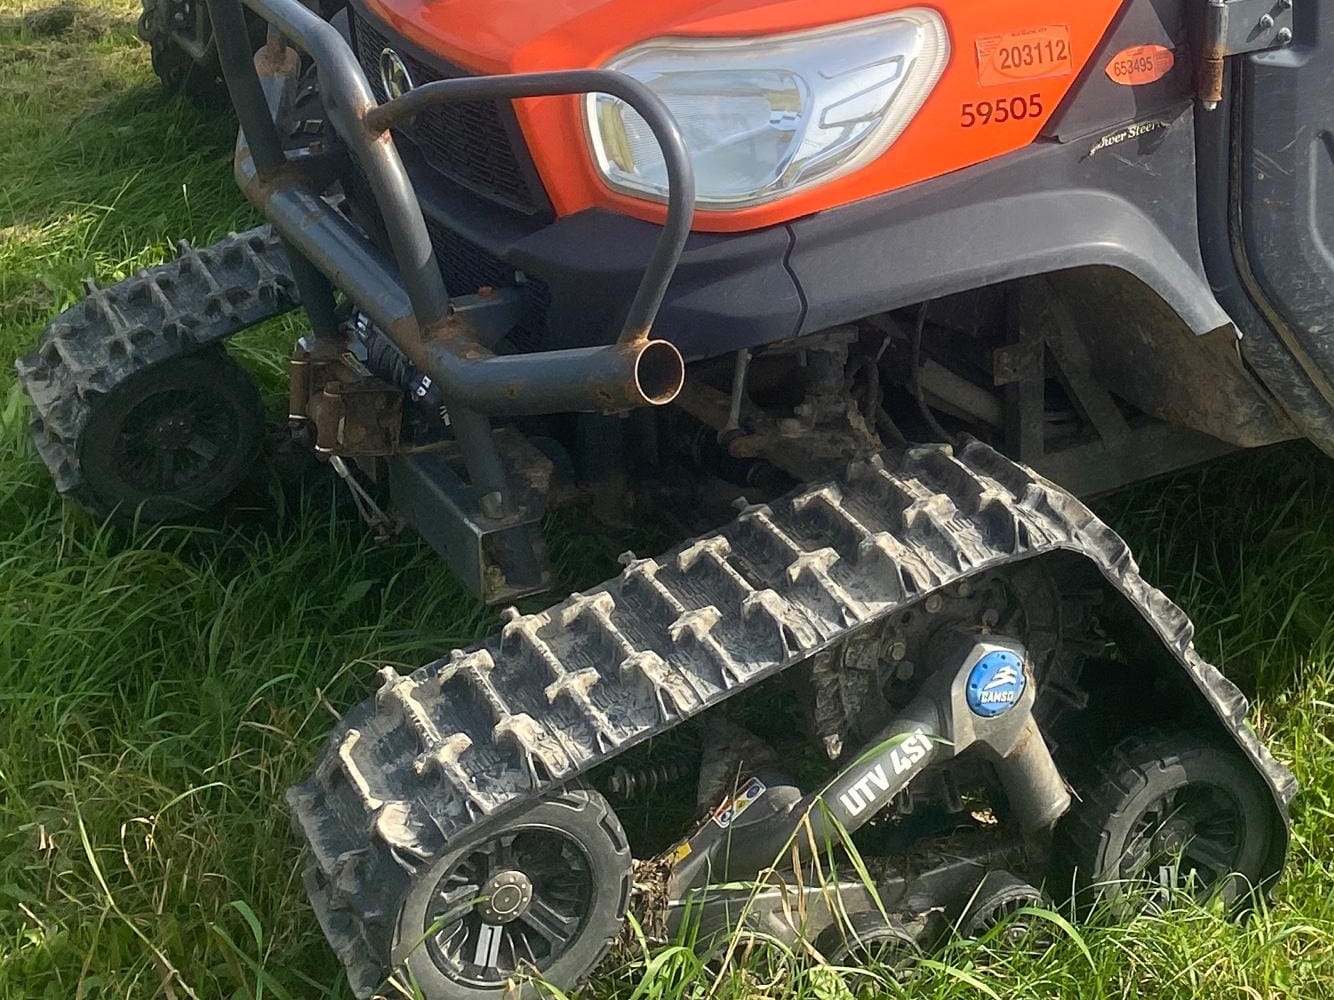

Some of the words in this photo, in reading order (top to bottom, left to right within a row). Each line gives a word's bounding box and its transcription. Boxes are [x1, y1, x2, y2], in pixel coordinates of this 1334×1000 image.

[999, 39, 1068, 70] 203112
[1113, 56, 1154, 77] 653495
[960, 93, 1043, 128] 59505
[839, 763, 890, 817] UTV
